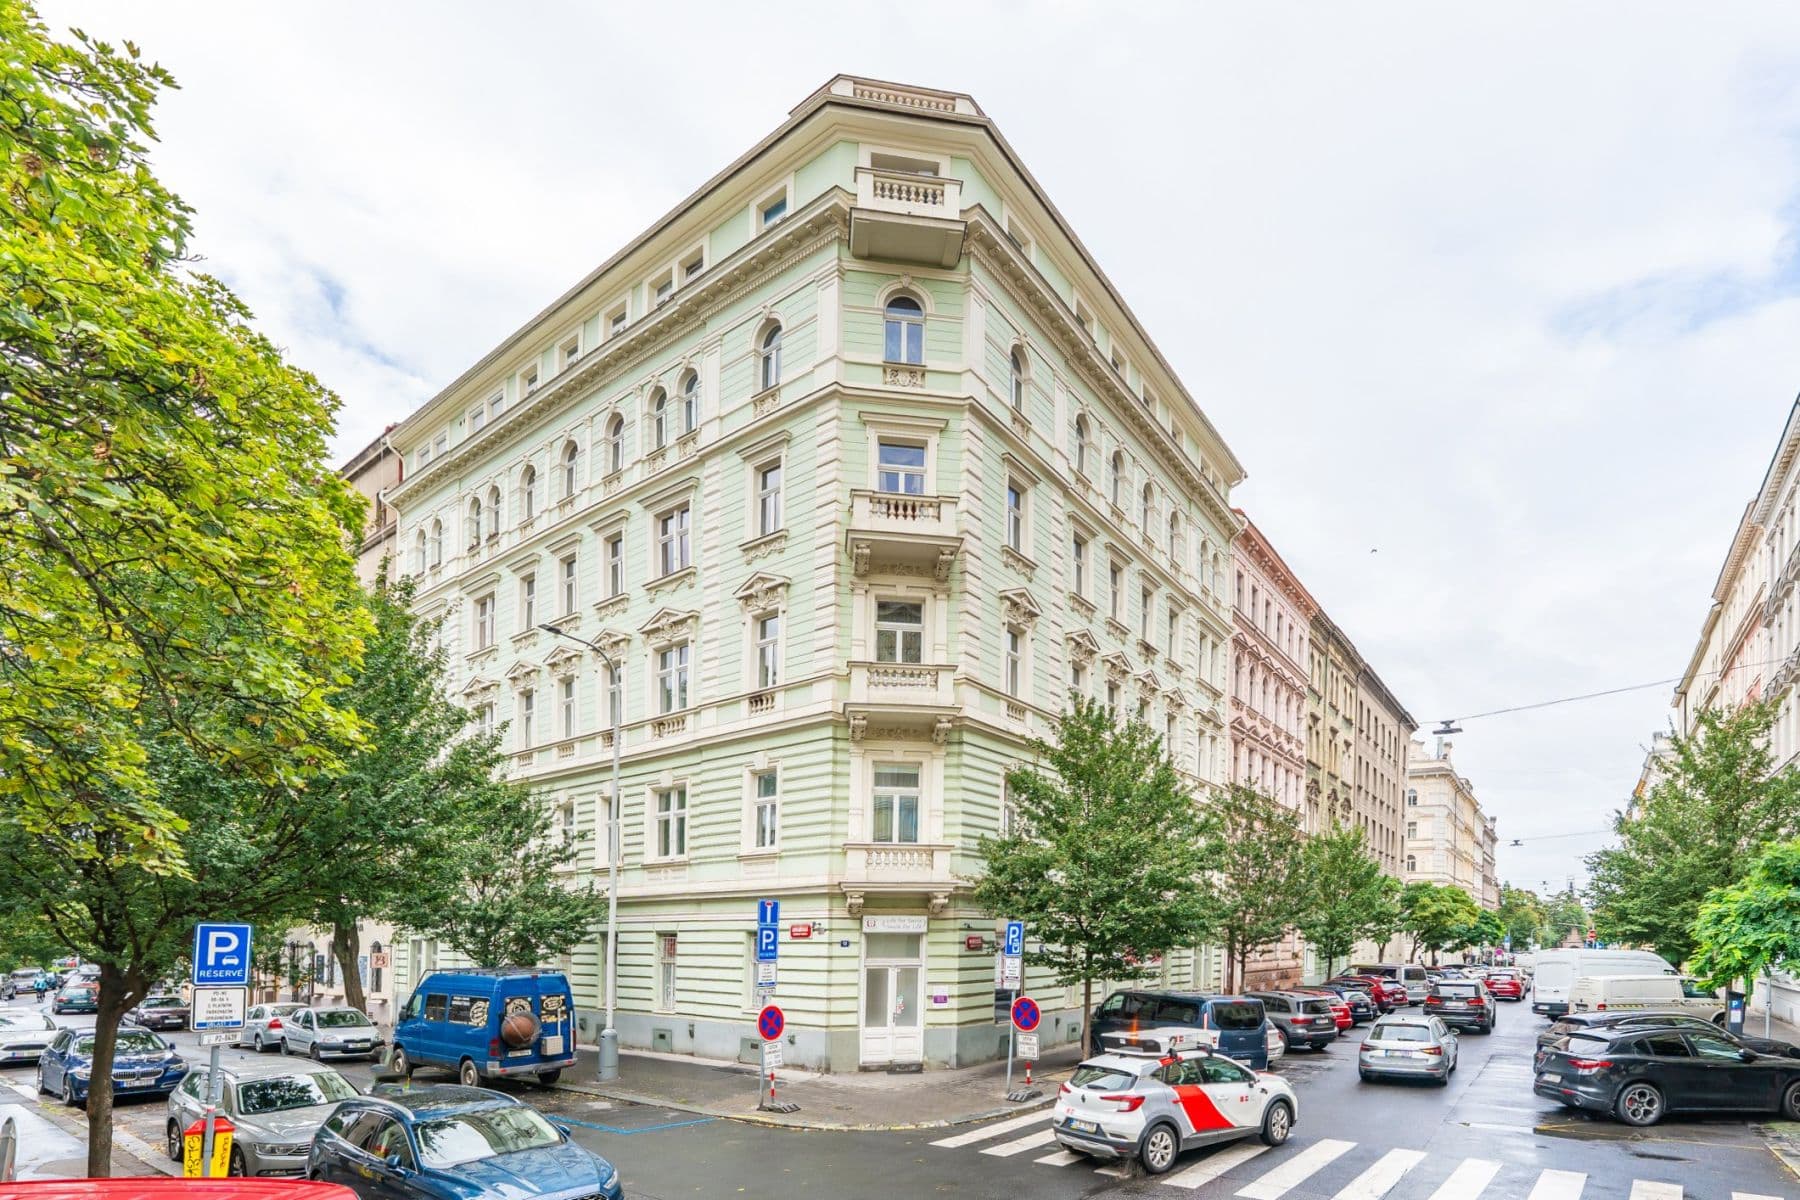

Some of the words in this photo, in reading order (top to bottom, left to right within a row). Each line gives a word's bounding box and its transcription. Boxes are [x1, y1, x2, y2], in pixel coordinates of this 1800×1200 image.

[762, 930, 774, 950] P
[1008, 926, 1019, 946] P
[207, 931, 239, 966] P
[199, 967, 244, 978] RÉSERVÉ
